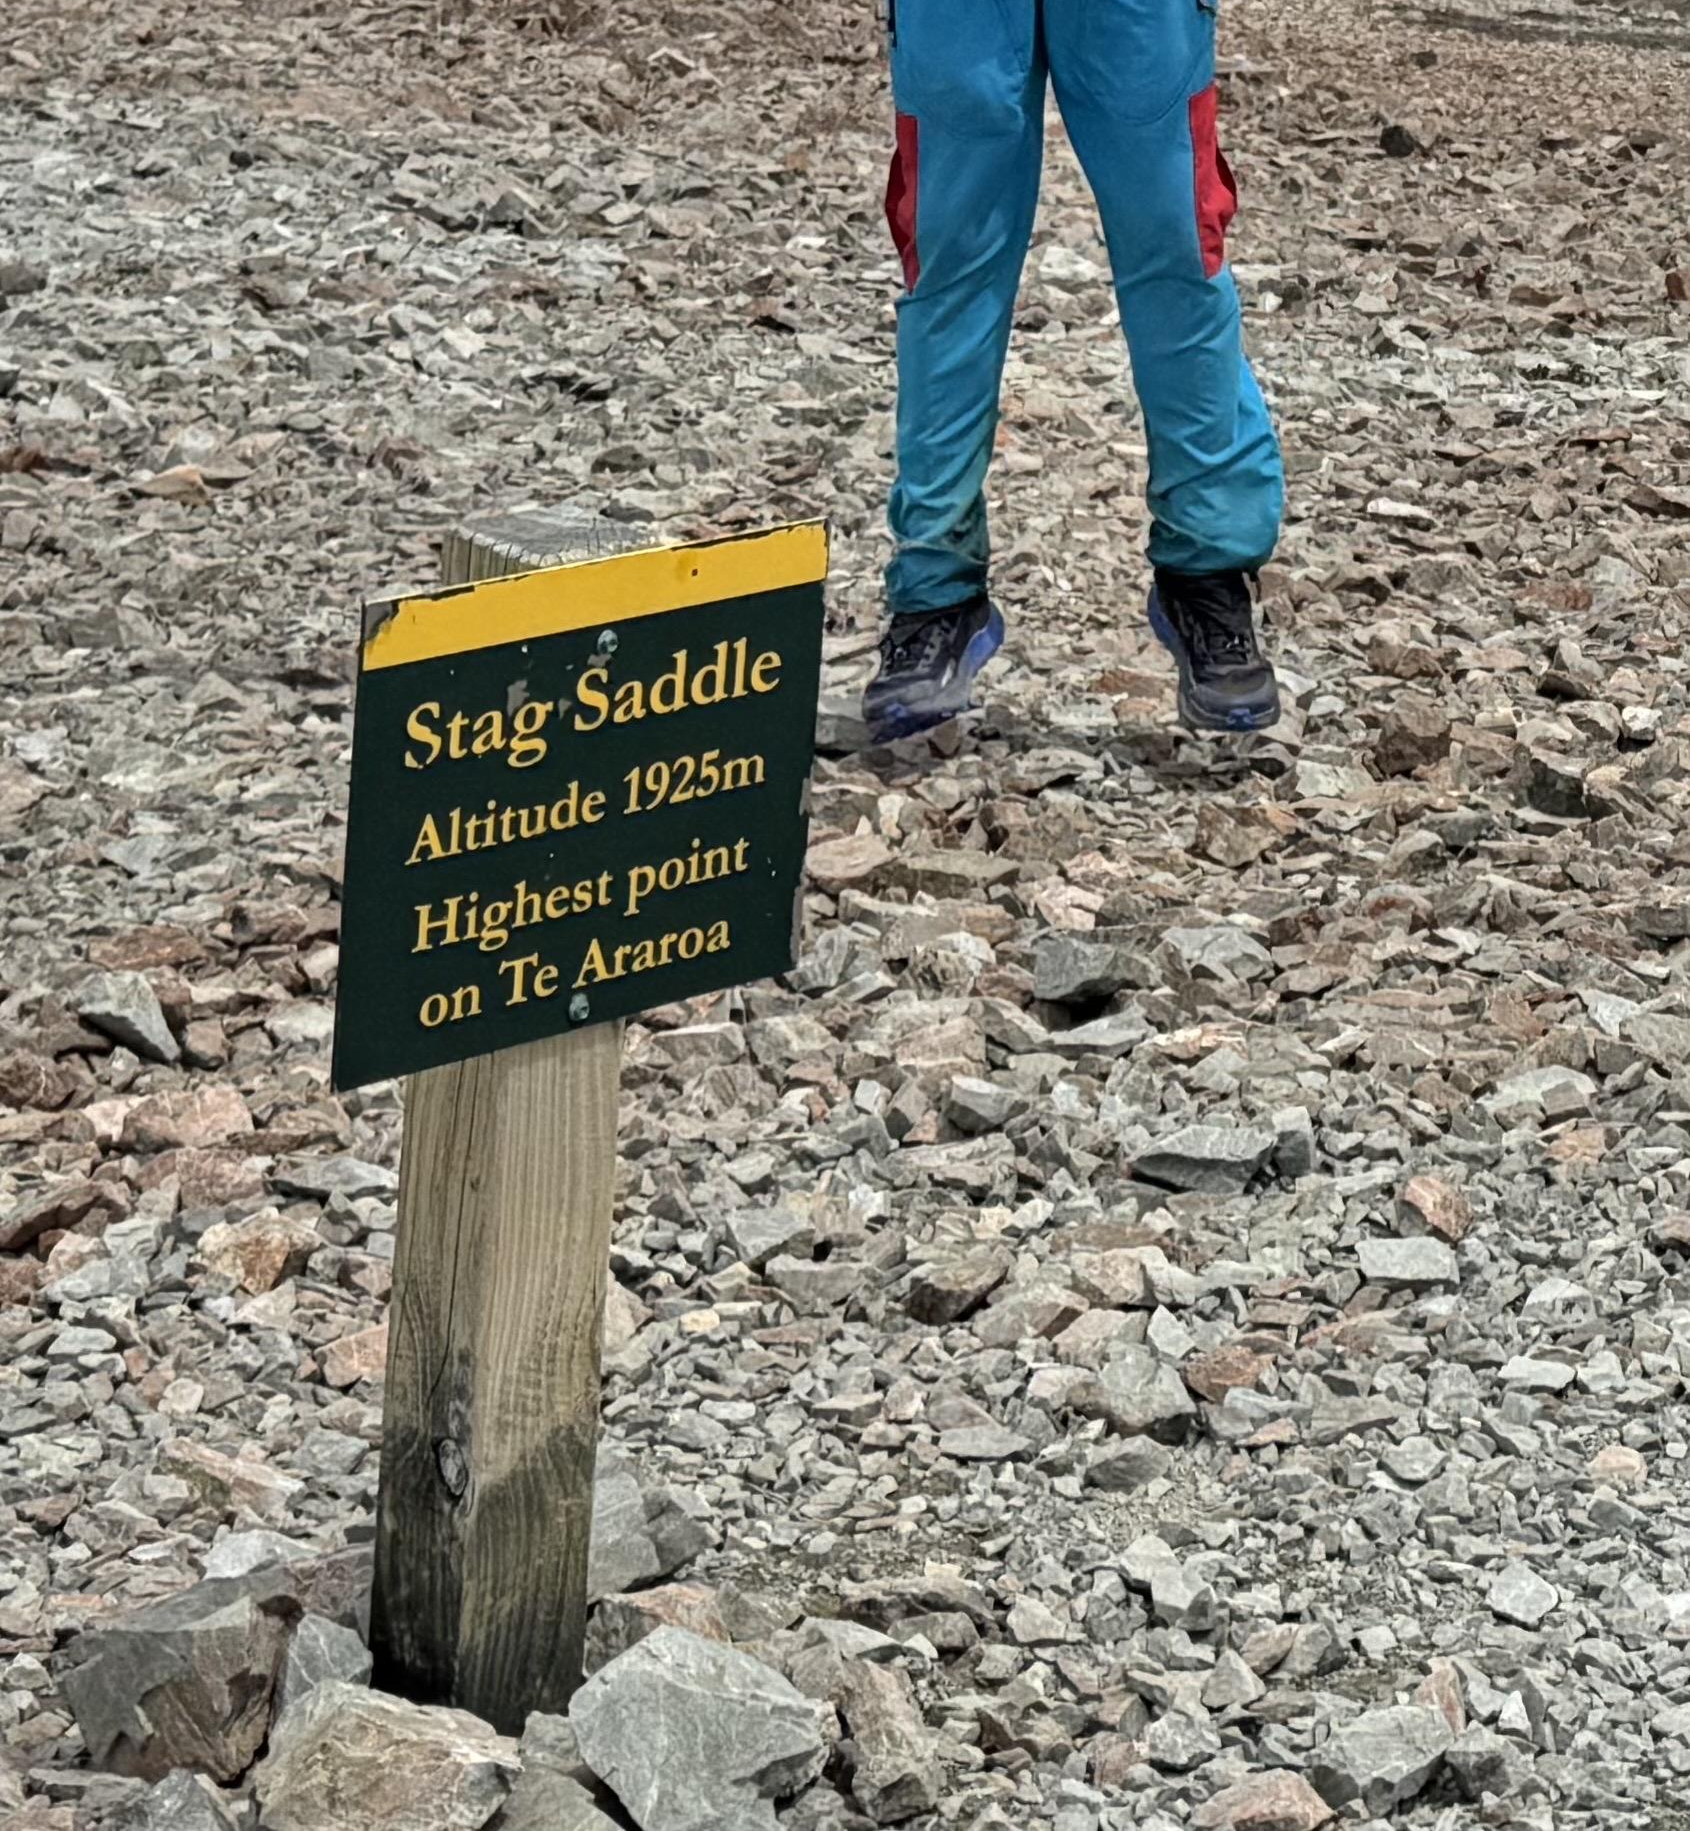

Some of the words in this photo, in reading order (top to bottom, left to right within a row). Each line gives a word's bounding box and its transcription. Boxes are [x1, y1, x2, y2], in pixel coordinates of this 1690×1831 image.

[404, 701, 555, 769] Stag
[573, 636, 783, 732] Saddle
[404, 780, 607, 866] Altitude
[621, 747, 766, 815] 1925m
[410, 871, 613, 954] Highest
[622, 836, 751, 917] point
[418, 982, 483, 1029] on
[498, 953, 560, 1007] Te
[571, 918, 731, 989] Araroa
